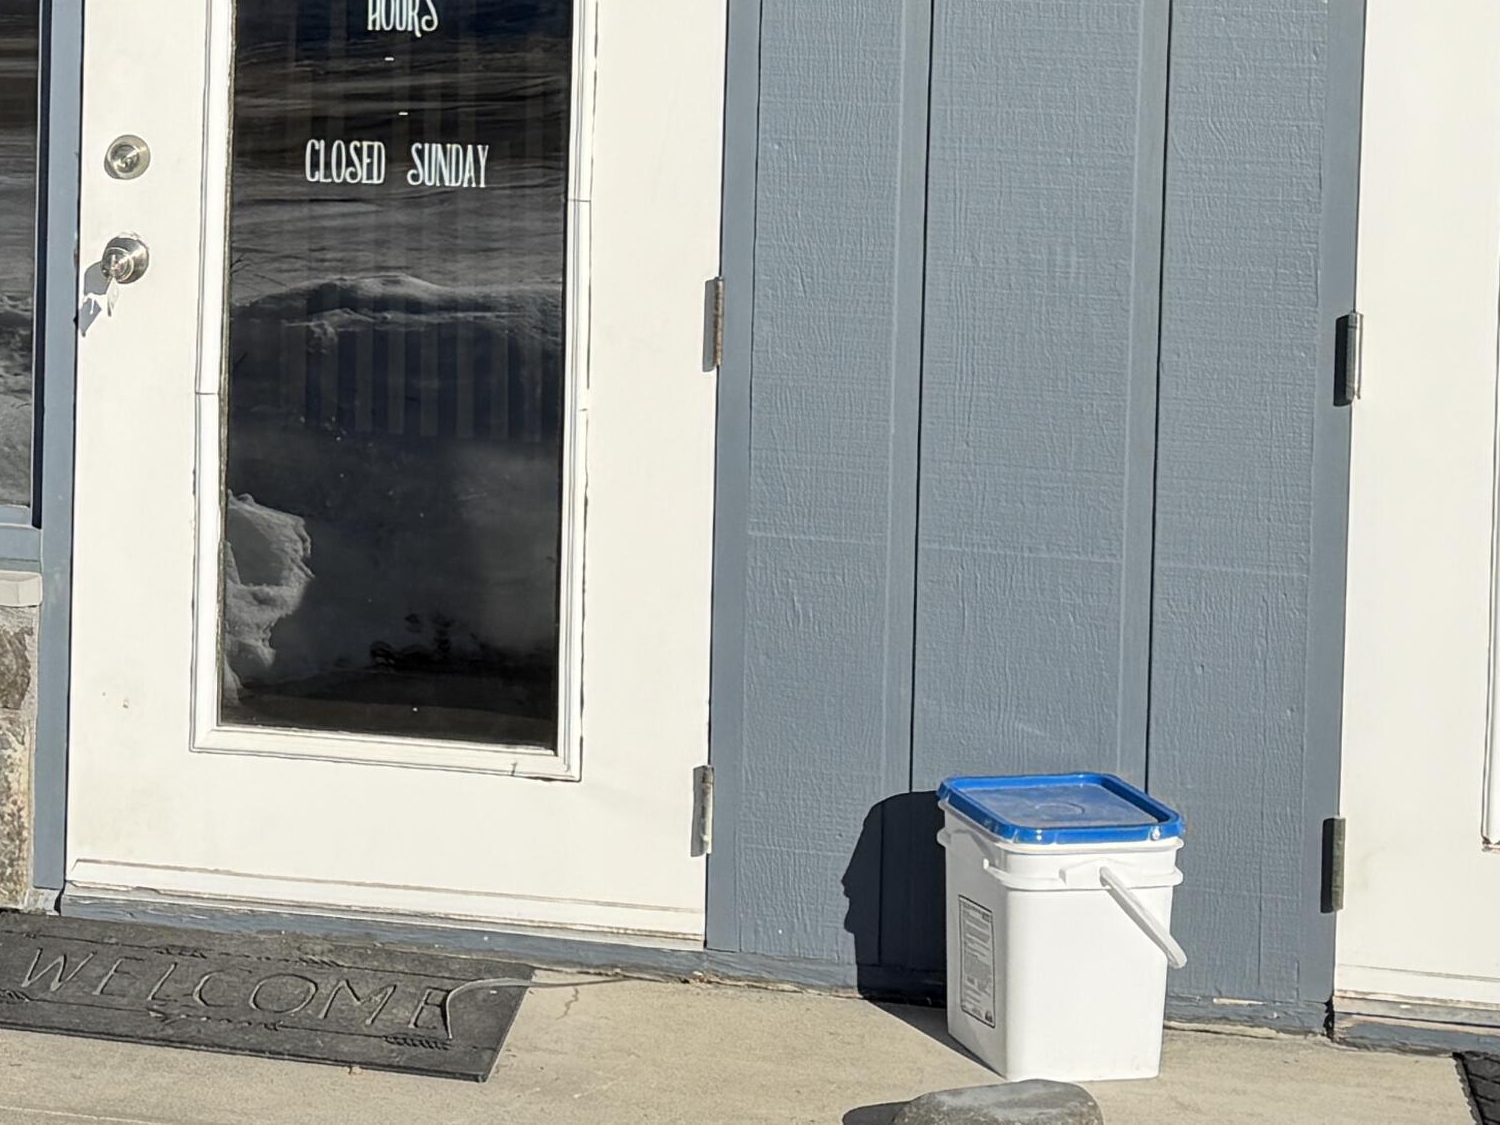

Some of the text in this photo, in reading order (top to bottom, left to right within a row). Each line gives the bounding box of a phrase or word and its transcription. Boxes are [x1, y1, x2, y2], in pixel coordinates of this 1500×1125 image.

[305, 139, 489, 188] CLOSED SUNDAY
[20, 946, 450, 1031] WELCOME
